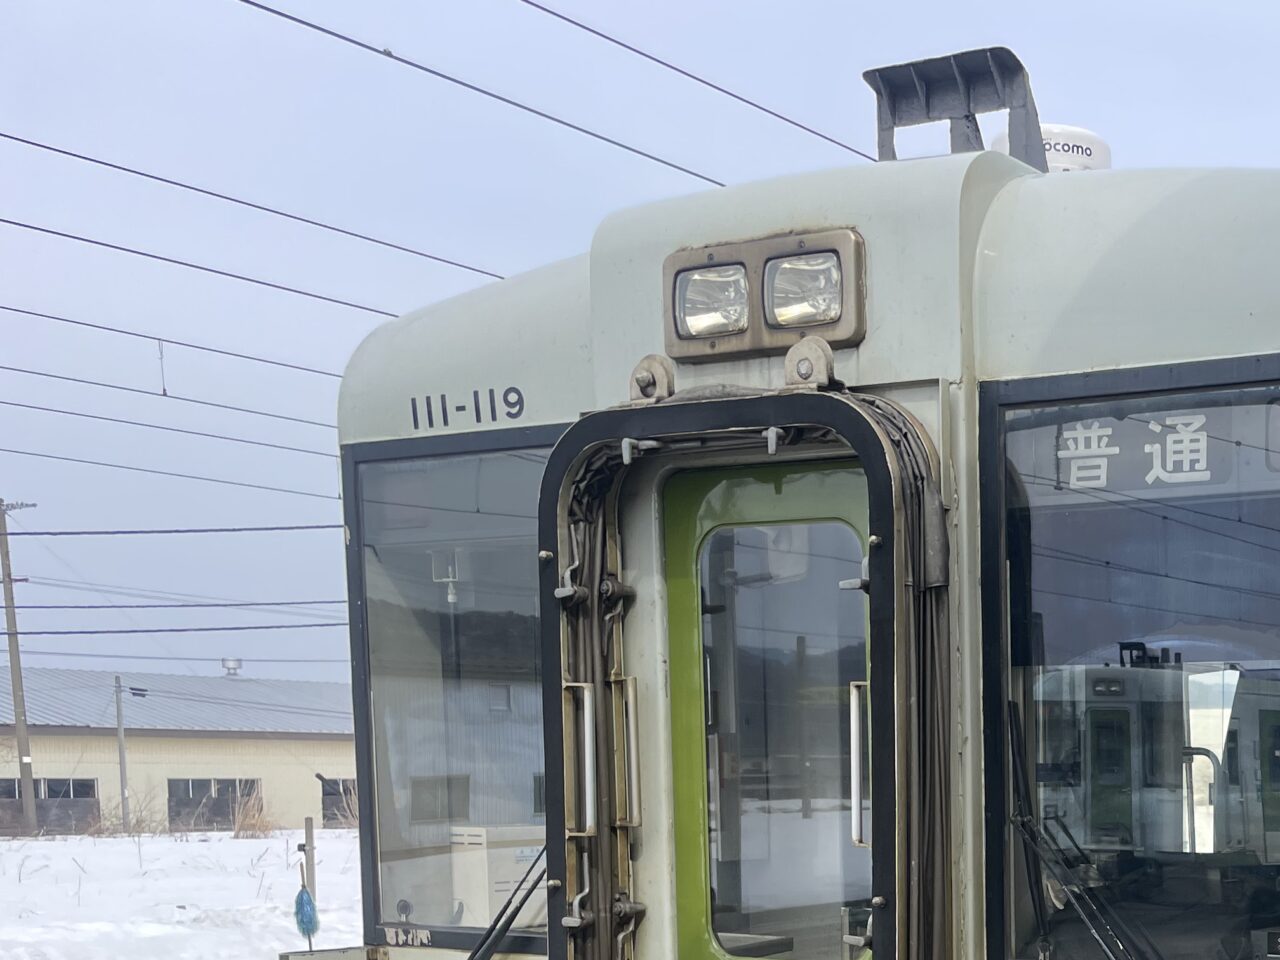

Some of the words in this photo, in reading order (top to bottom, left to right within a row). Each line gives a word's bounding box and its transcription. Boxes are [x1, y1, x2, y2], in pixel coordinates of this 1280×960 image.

[1043, 142, 1092, 157] ocomo
[411, 386, 524, 430] 111-119
[1057, 415, 1211, 488] 普通
